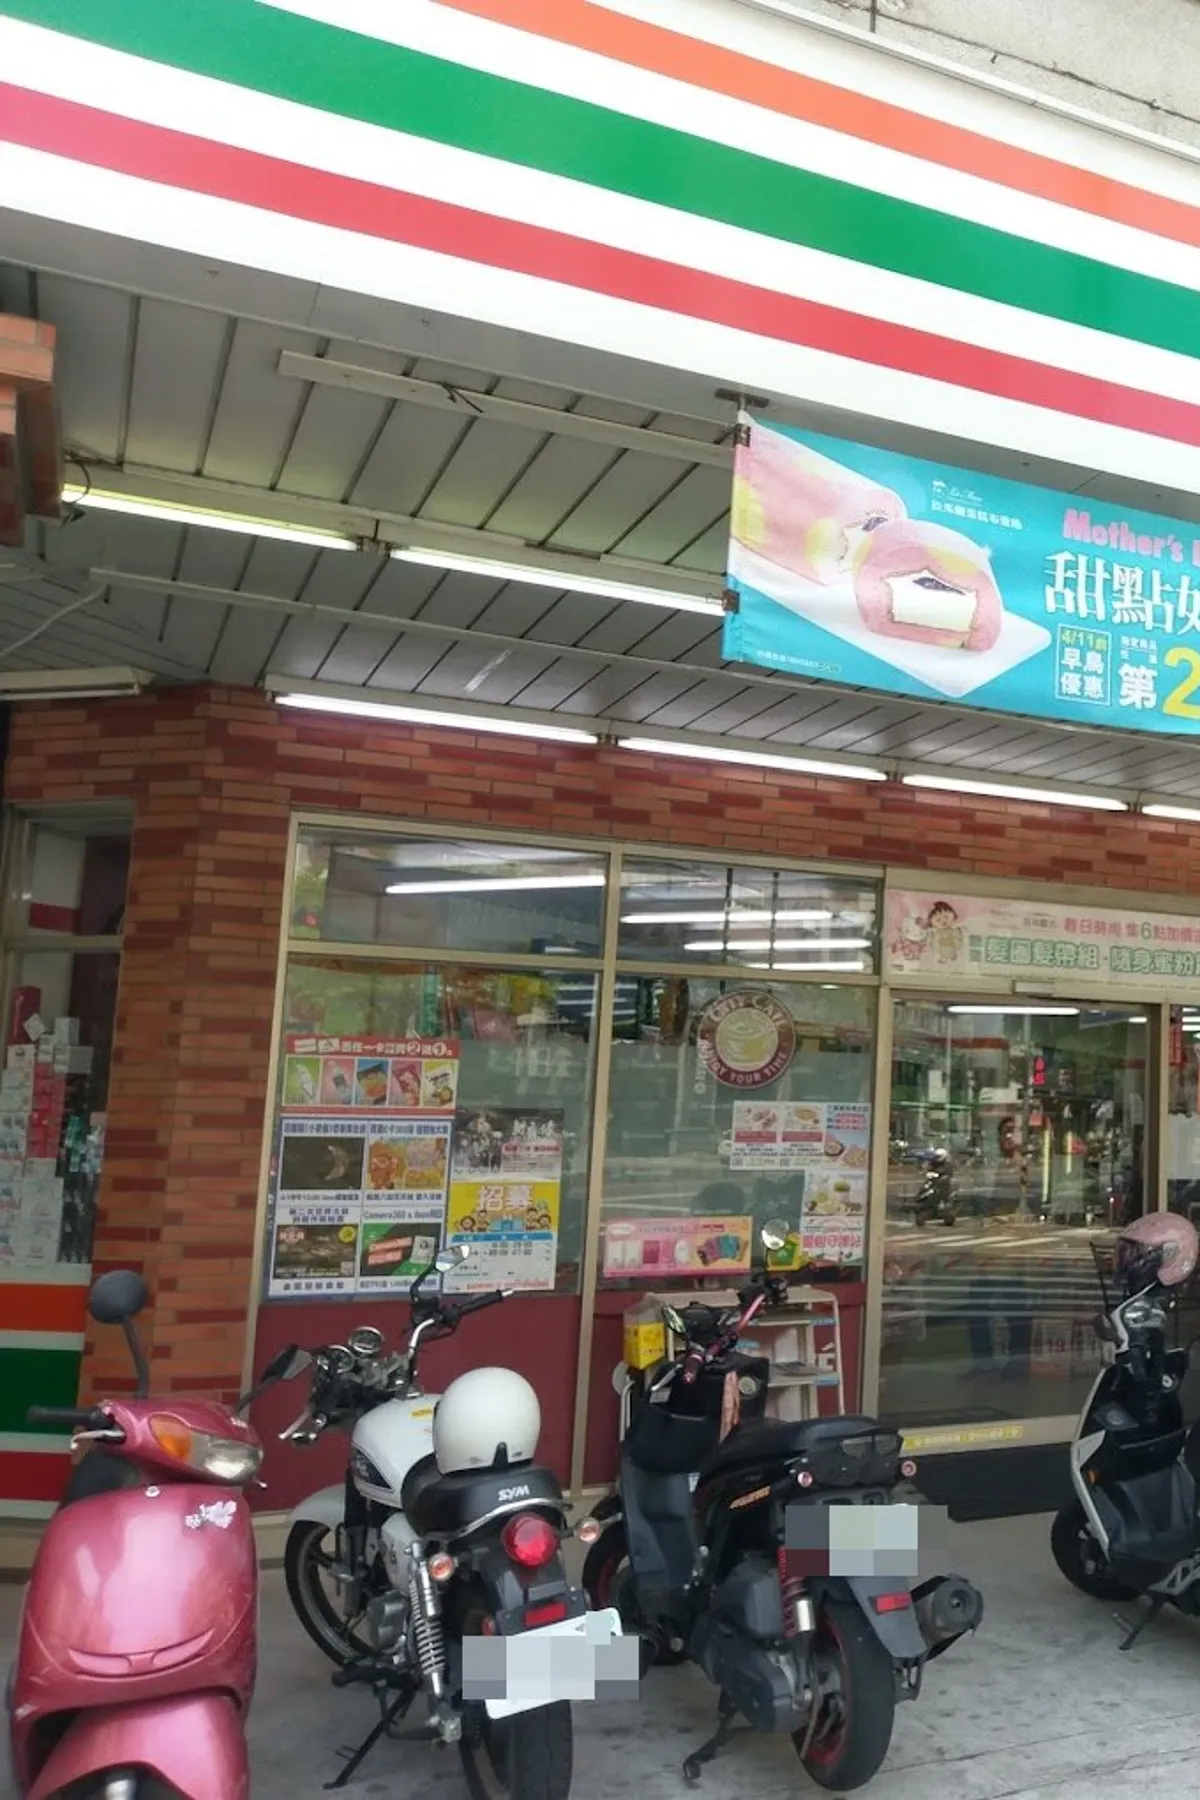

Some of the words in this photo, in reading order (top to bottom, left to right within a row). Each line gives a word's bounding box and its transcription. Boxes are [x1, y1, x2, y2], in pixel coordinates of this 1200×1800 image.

[1062, 508, 1184, 563] Mother's
[730, 1071, 762, 1085] YOUR
[498, 1484, 531, 1502] SYM
